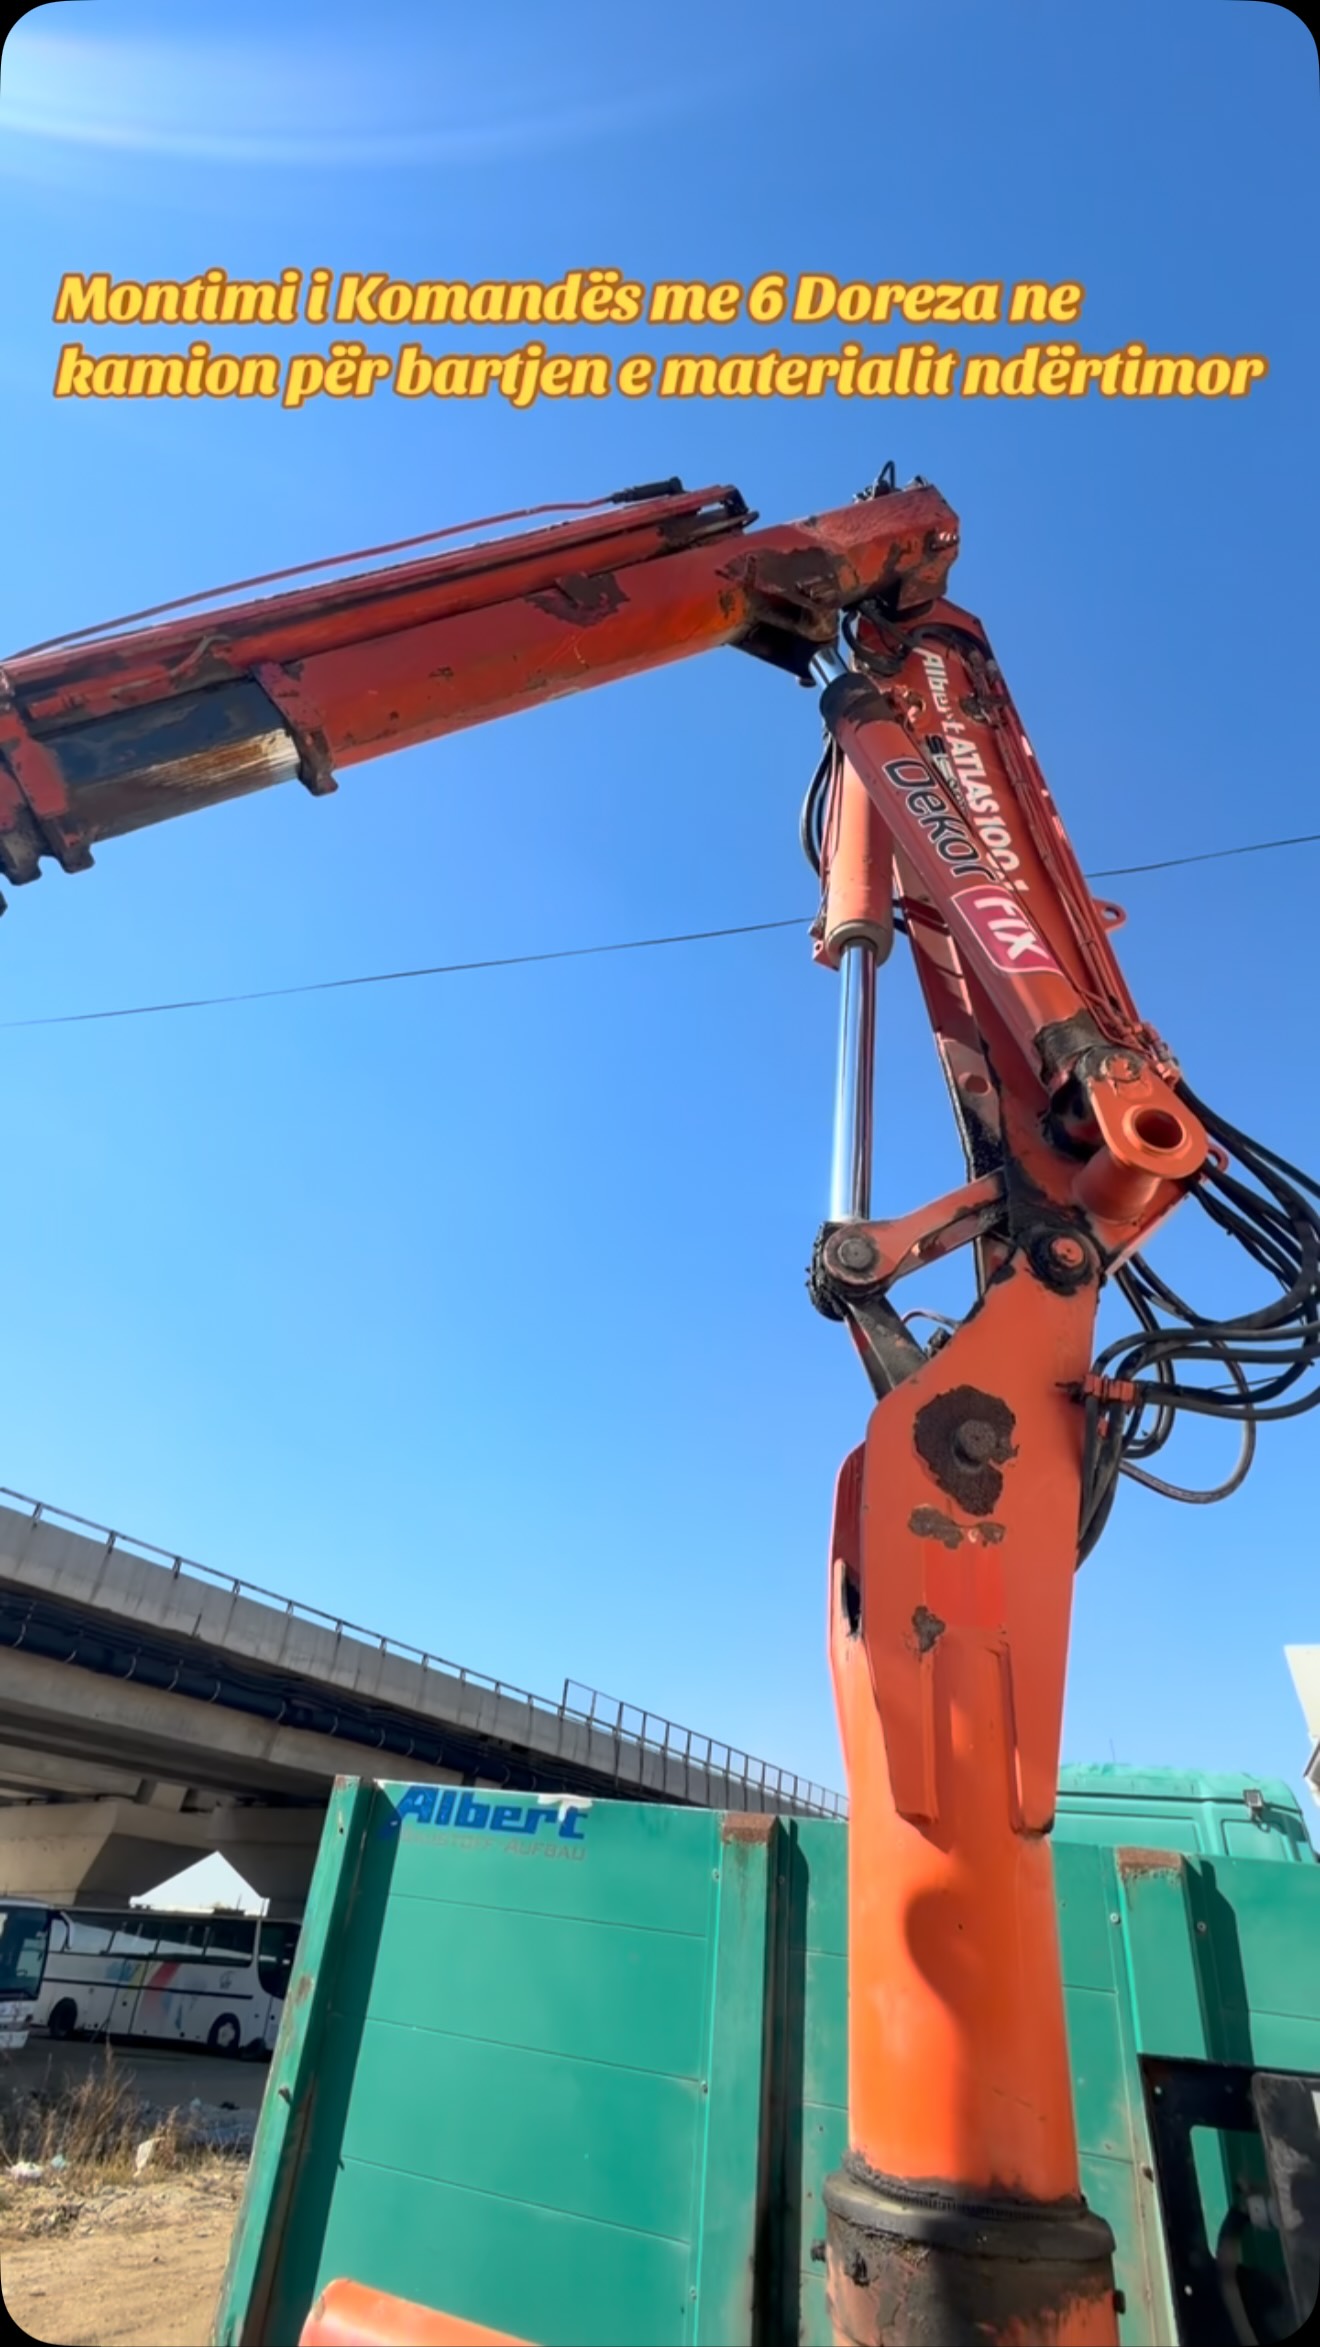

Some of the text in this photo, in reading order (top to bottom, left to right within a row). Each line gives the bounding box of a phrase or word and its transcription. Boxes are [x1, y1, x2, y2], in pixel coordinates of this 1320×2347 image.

[945, 735, 1000, 814] ATLAS
[881, 758, 998, 884] Dekor
[378, 1785, 588, 1839] Albert
[503, 1837, 586, 1862] AUFBAU
